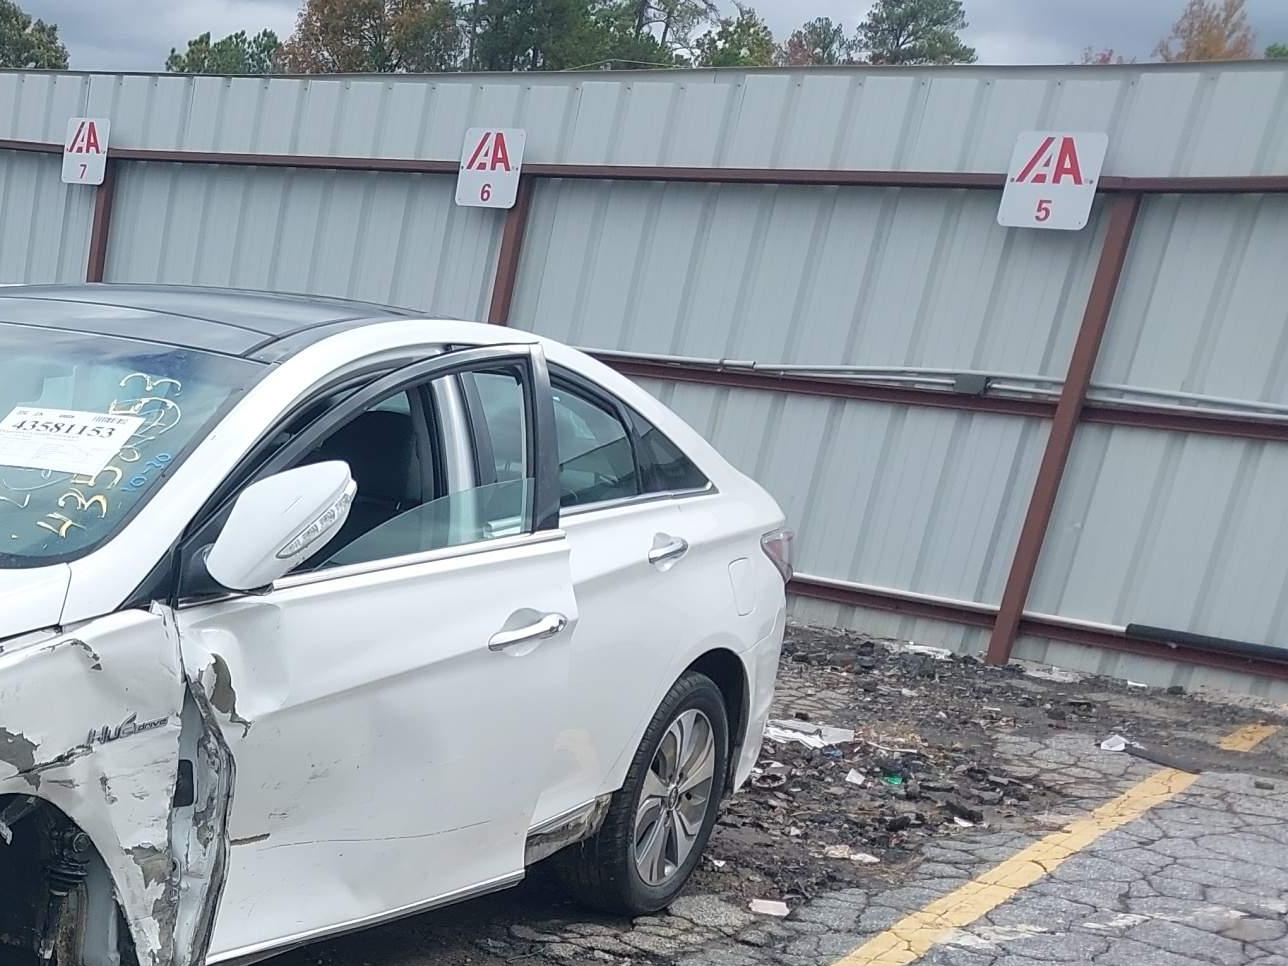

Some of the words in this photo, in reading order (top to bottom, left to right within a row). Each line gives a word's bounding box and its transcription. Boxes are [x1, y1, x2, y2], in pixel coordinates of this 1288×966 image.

[79, 163, 88, 180] 7
[480, 182, 492, 201] 6
[1034, 199, 1053, 222] 5
[12, 419, 116, 439] 43581153
